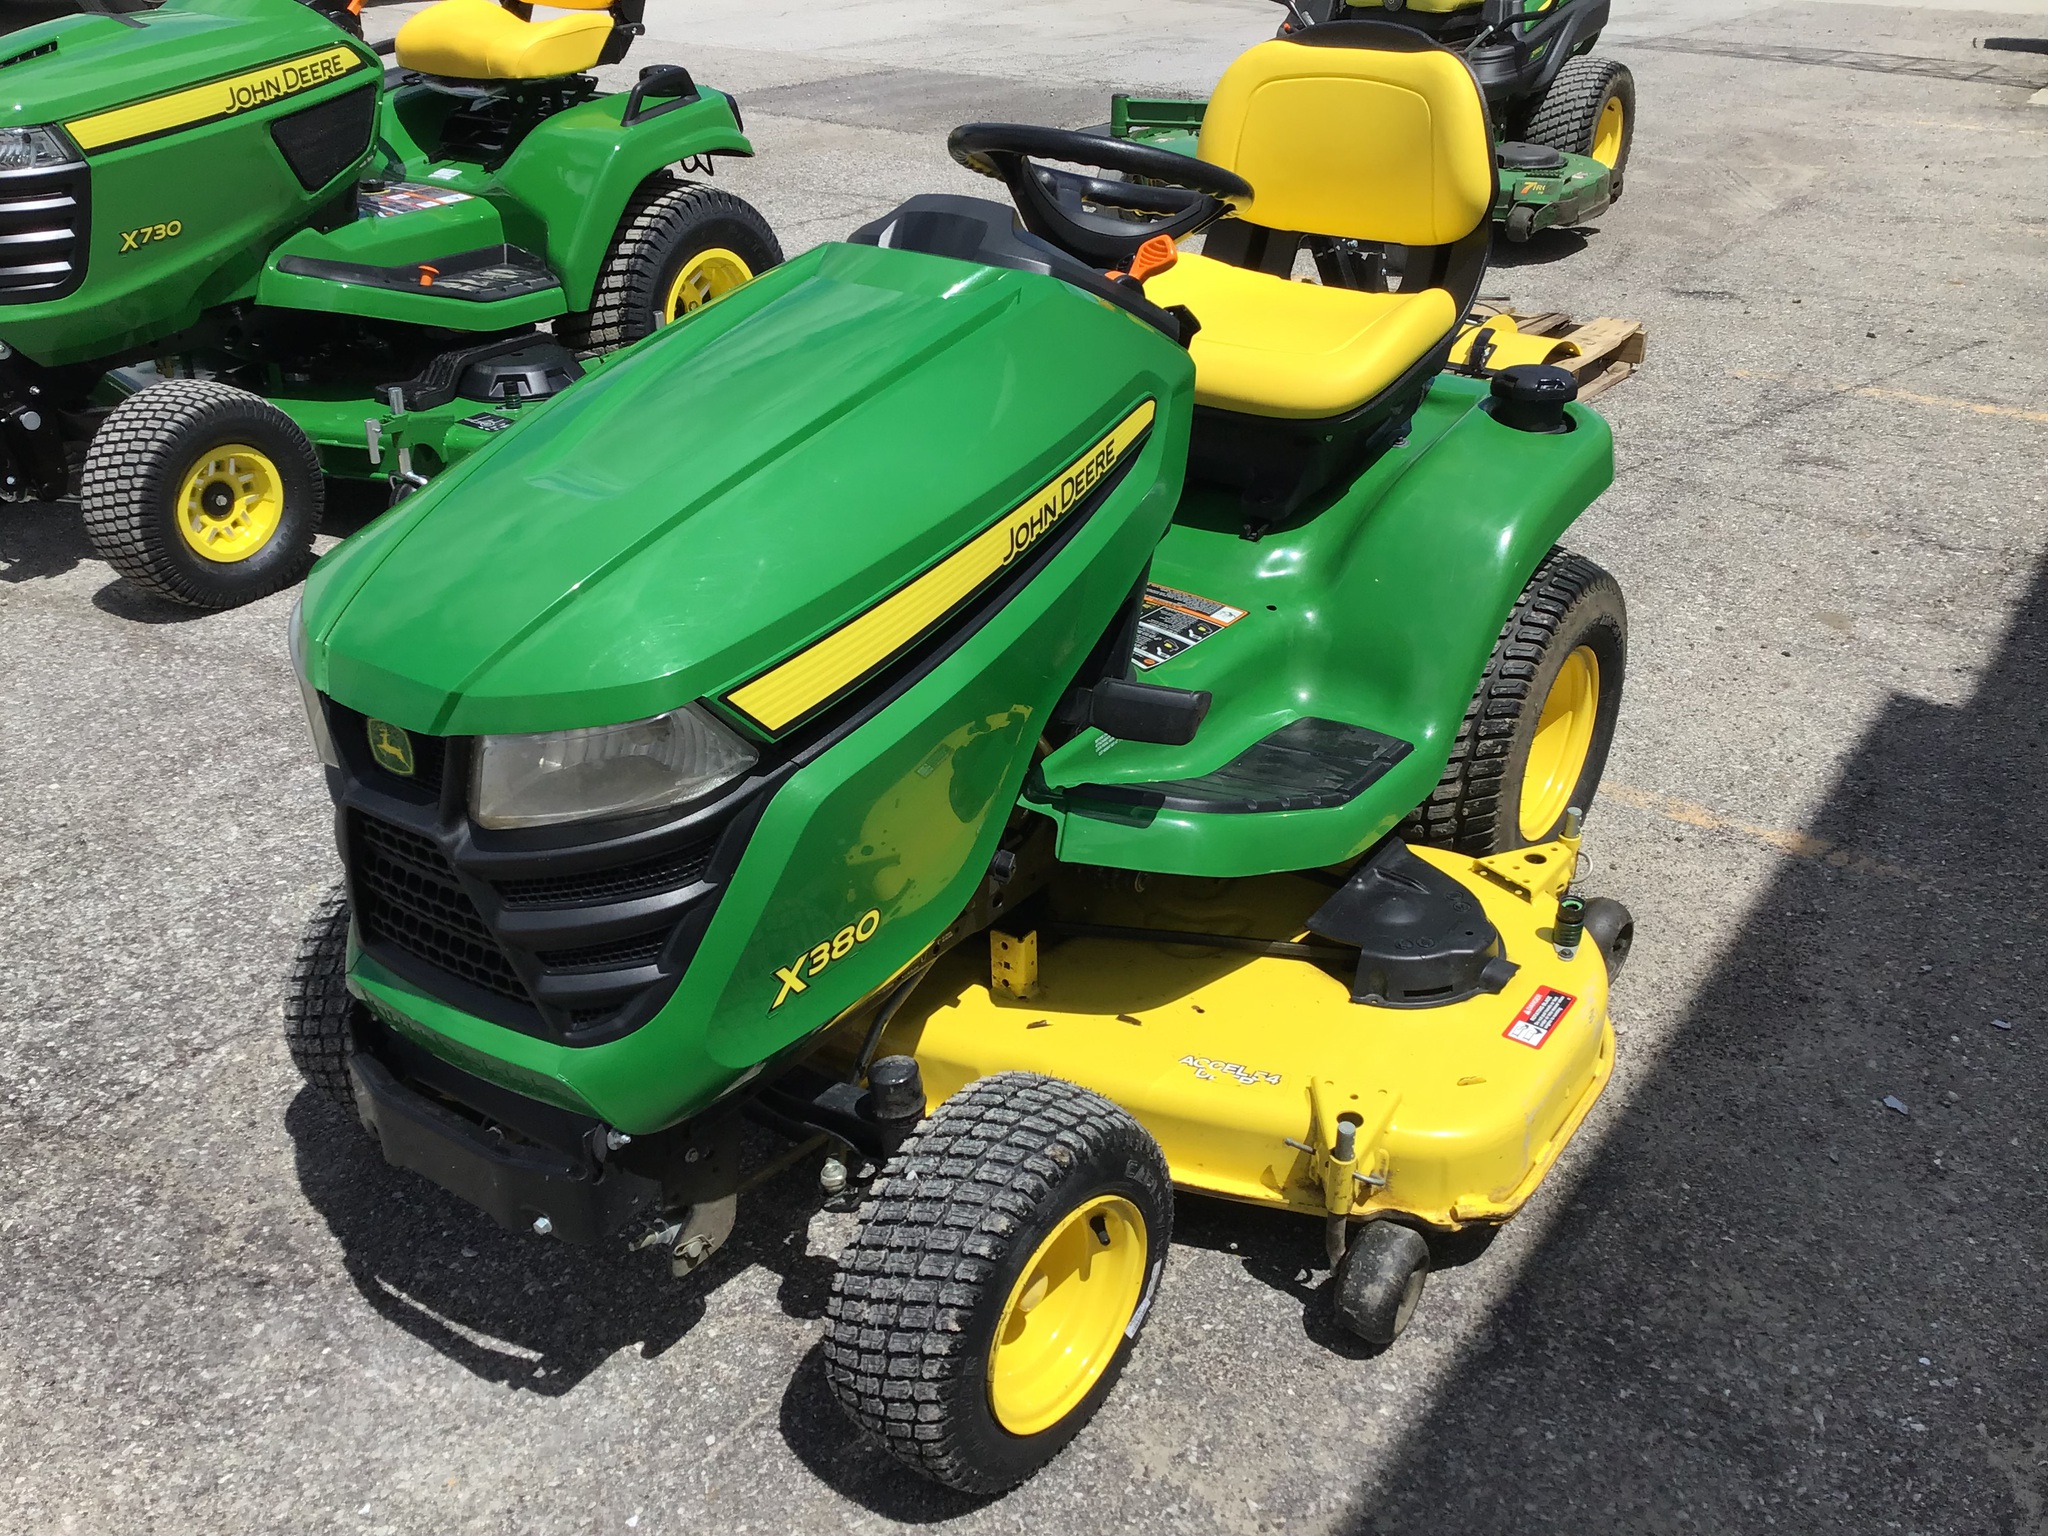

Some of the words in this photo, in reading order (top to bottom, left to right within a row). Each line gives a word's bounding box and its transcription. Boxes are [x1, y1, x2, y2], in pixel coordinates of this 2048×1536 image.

[225, 76, 281, 112] JOHN
[282, 54, 344, 90] DEERE
[120, 220, 182, 253] X730
[1003, 495, 1057, 563] JOHN
[1061, 438, 1115, 511] DEERE
[770, 908, 881, 1012] X380
